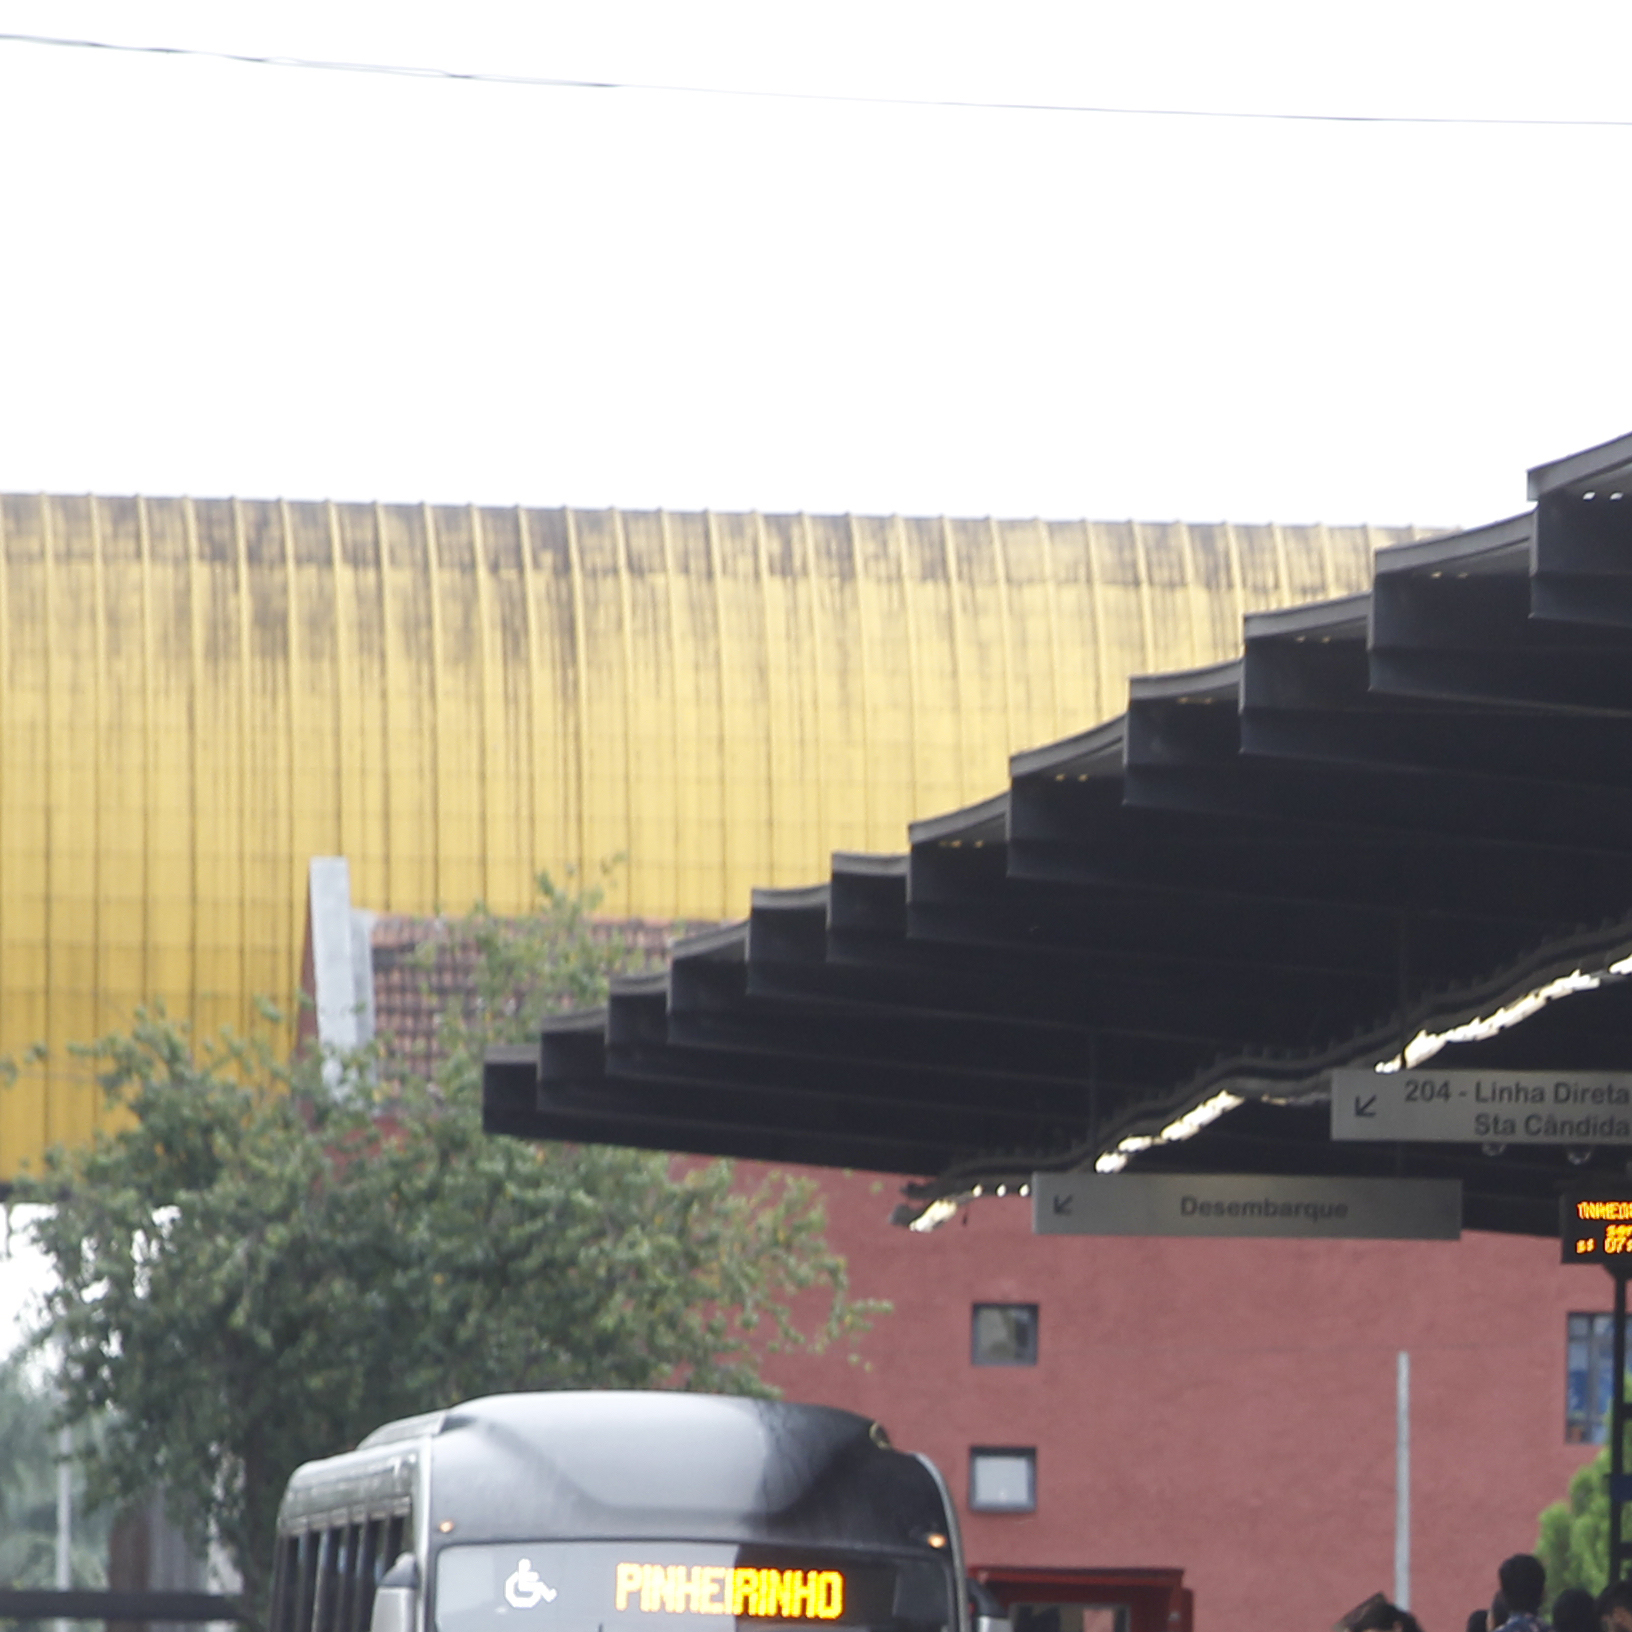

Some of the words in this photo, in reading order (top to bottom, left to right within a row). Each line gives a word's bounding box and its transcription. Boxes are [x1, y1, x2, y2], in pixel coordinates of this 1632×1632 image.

[1405, 1079, 1451, 1102] 204
[1475, 1081, 1546, 1104] Linha
[1554, 1082, 1630, 1105] Direta
[1473, 1112, 1517, 1137] Sta
[1523, 1112, 1630, 1138] Cândida
[1179, 1193, 1350, 1224] Desembarque
[614, 1560, 845, 1621] PINHEIRINHO
